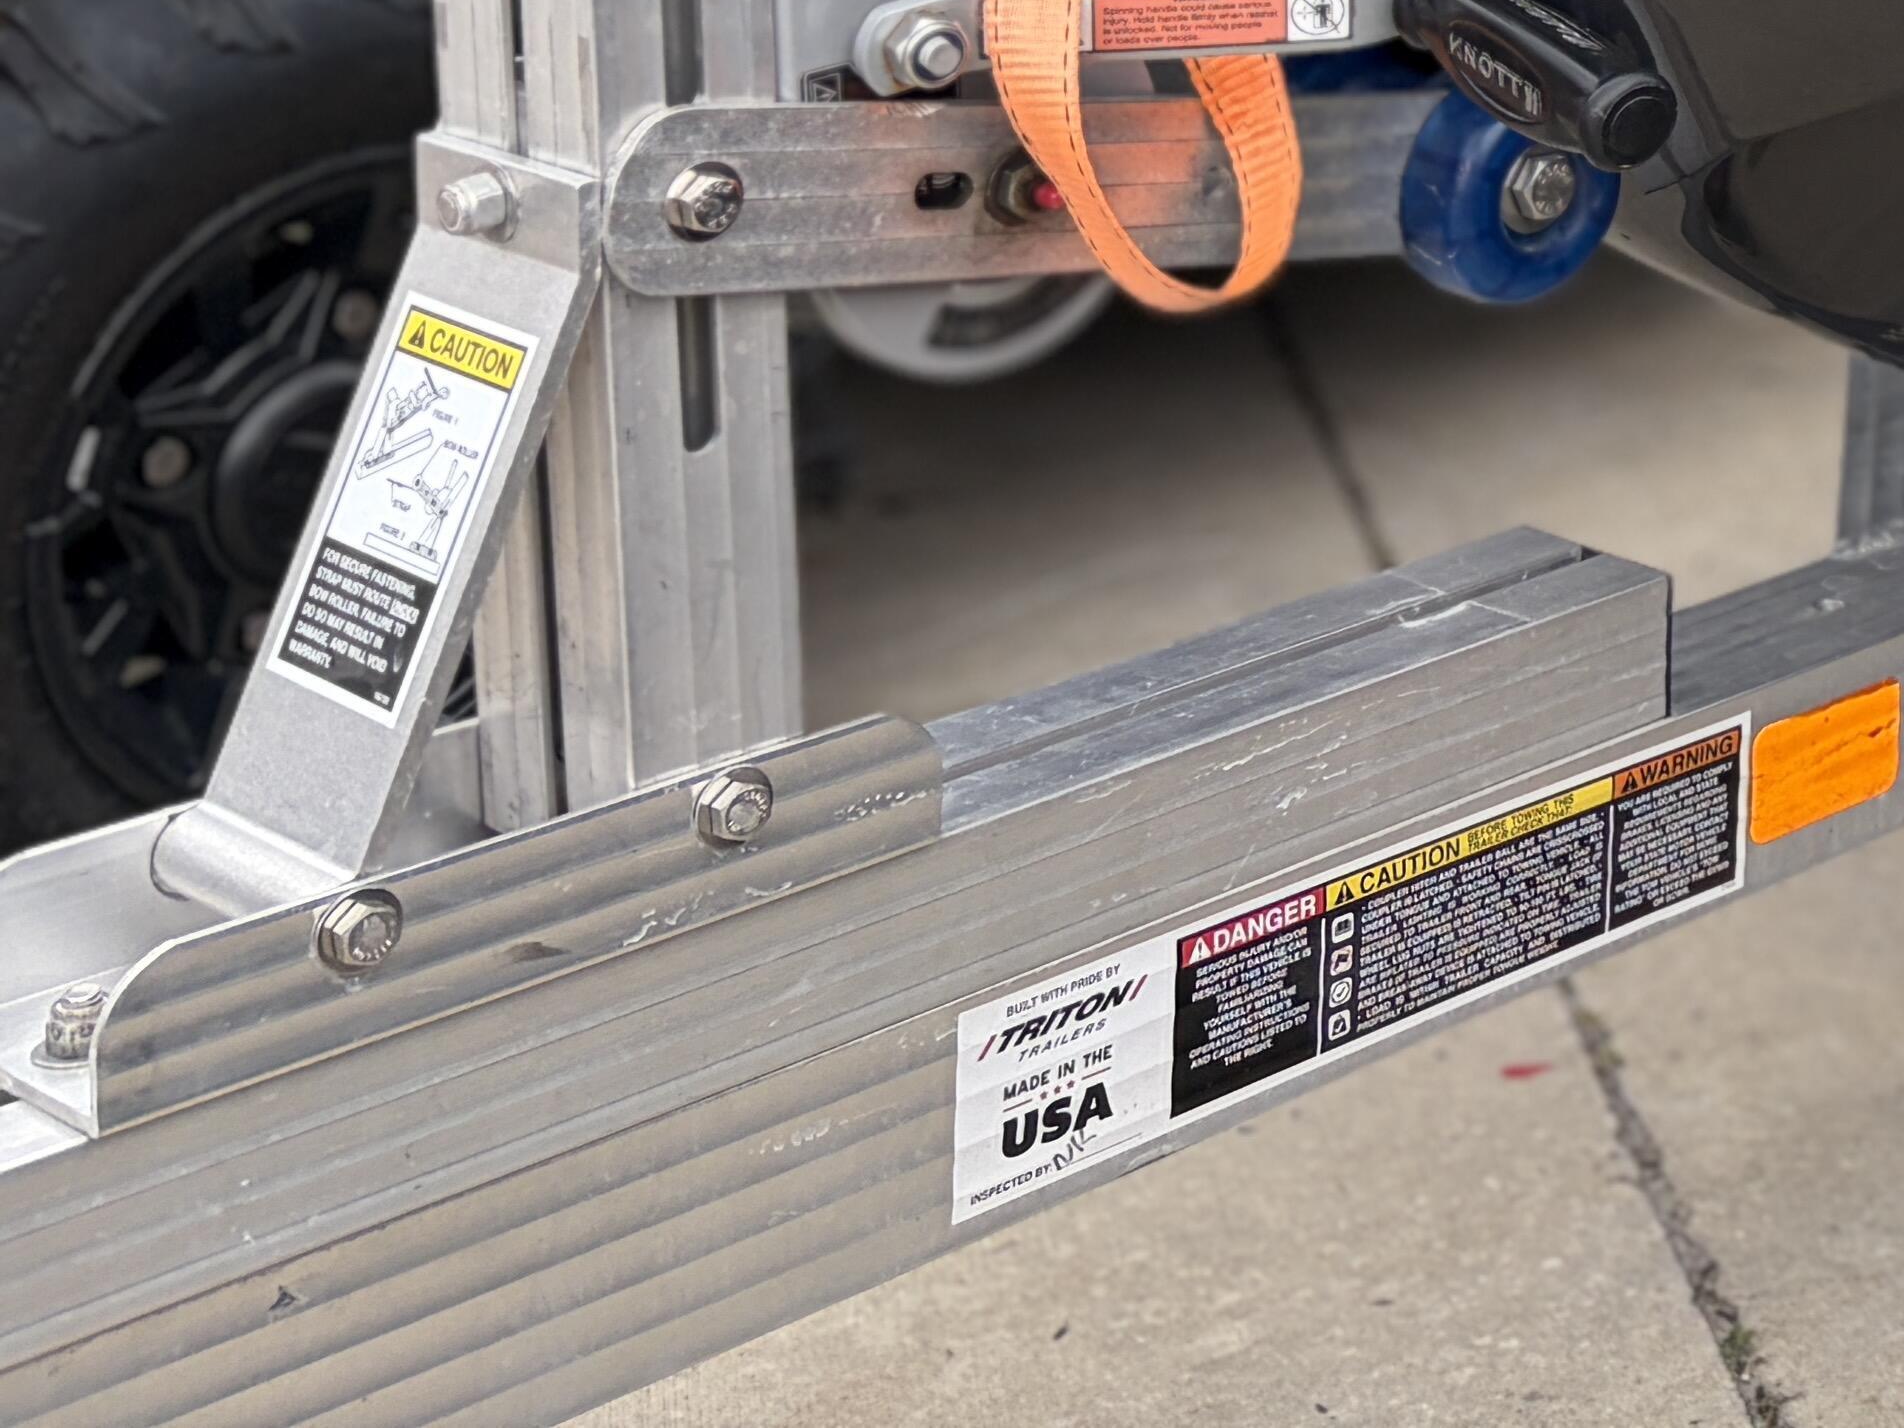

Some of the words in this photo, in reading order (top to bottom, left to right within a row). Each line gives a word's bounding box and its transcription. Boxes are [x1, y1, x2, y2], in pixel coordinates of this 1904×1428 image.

[1447, 30, 1524, 100] KNOTT
[429, 327, 515, 380] CAUTION
[314, 564, 343, 587] STRAP
[339, 576, 365, 598] MUST
[362, 586, 391, 609] ROUTE
[321, 546, 341, 565] FOR
[338, 554, 372, 579] SECURE
[301, 600, 316, 618] DO
[313, 606, 328, 624] SO
[325, 612, 345, 632] MAY
[342, 620, 375, 645] RESULT
[372, 634, 385, 650] IN
[307, 583, 329, 603] BOW
[359, 606, 394, 632] FAILURE
[391, 620, 407, 638] TO
[329, 635, 348, 655] AND
[346, 643, 368, 664] WILL
[365, 652, 388, 674] VOID
[1640, 733, 1733, 787] WARNING
[1467, 819, 1505, 842] BEFORE
[1512, 802, 1549, 825] TOWING
[1553, 792, 1574, 809] THIS
[1468, 828, 1508, 853] TRAILER
[1511, 814, 1542, 836] CHECK
[1359, 836, 1460, 895] CAUTION
[1213, 892, 1316, 954] DANGER
[1192, 979, 1226, 1002] RESULT
[1229, 975, 1237, 987] IF
[1240, 966, 1260, 982] THIS
[1262, 950, 1300, 974] VEHICLE
[1302, 946, 1311, 958] IS
[1195, 961, 1244, 989] PROPERTY
[1247, 944, 1287, 969] DAMAGE
[1287, 936, 1307, 952] CAN
[1196, 954, 1236, 978] SERIOUS
[1239, 940, 1271, 960] INJURY
[1215, 982, 1249, 1003] TOWED
[1250, 966, 1287, 989] BEFORE
[997, 978, 1134, 1054] TRITON
[1006, 995, 1038, 1017] BUILT
[1040, 983, 1067, 1003] WITH
[1070, 970, 1102, 992] PRIDE
[1106, 963, 1120, 978] BY
[1203, 1002, 1252, 1031] YOURSELF
[1254, 992, 1276, 1009] WITH
[1280, 984, 1296, 999] THE
[1018, 1017, 1106, 1062] TRAILERS
[1189, 1029, 1241, 1059] OPERATING
[1243, 1001, 1309, 1036] INSTRUCTIONS
[1190, 1053, 1211, 1069] AND
[1212, 1032, 1258, 1061] CAUTIONS
[1261, 1018, 1293, 1040] LISTED
[1294, 1012, 1306, 1026] TO
[1002, 1068, 1050, 1101] MADE
[1057, 1059, 1075, 1079] IN
[1082, 1044, 1112, 1068] THE
[1002, 1081, 1114, 1160] USA
[970, 1169, 1032, 1205] INSPECTED
